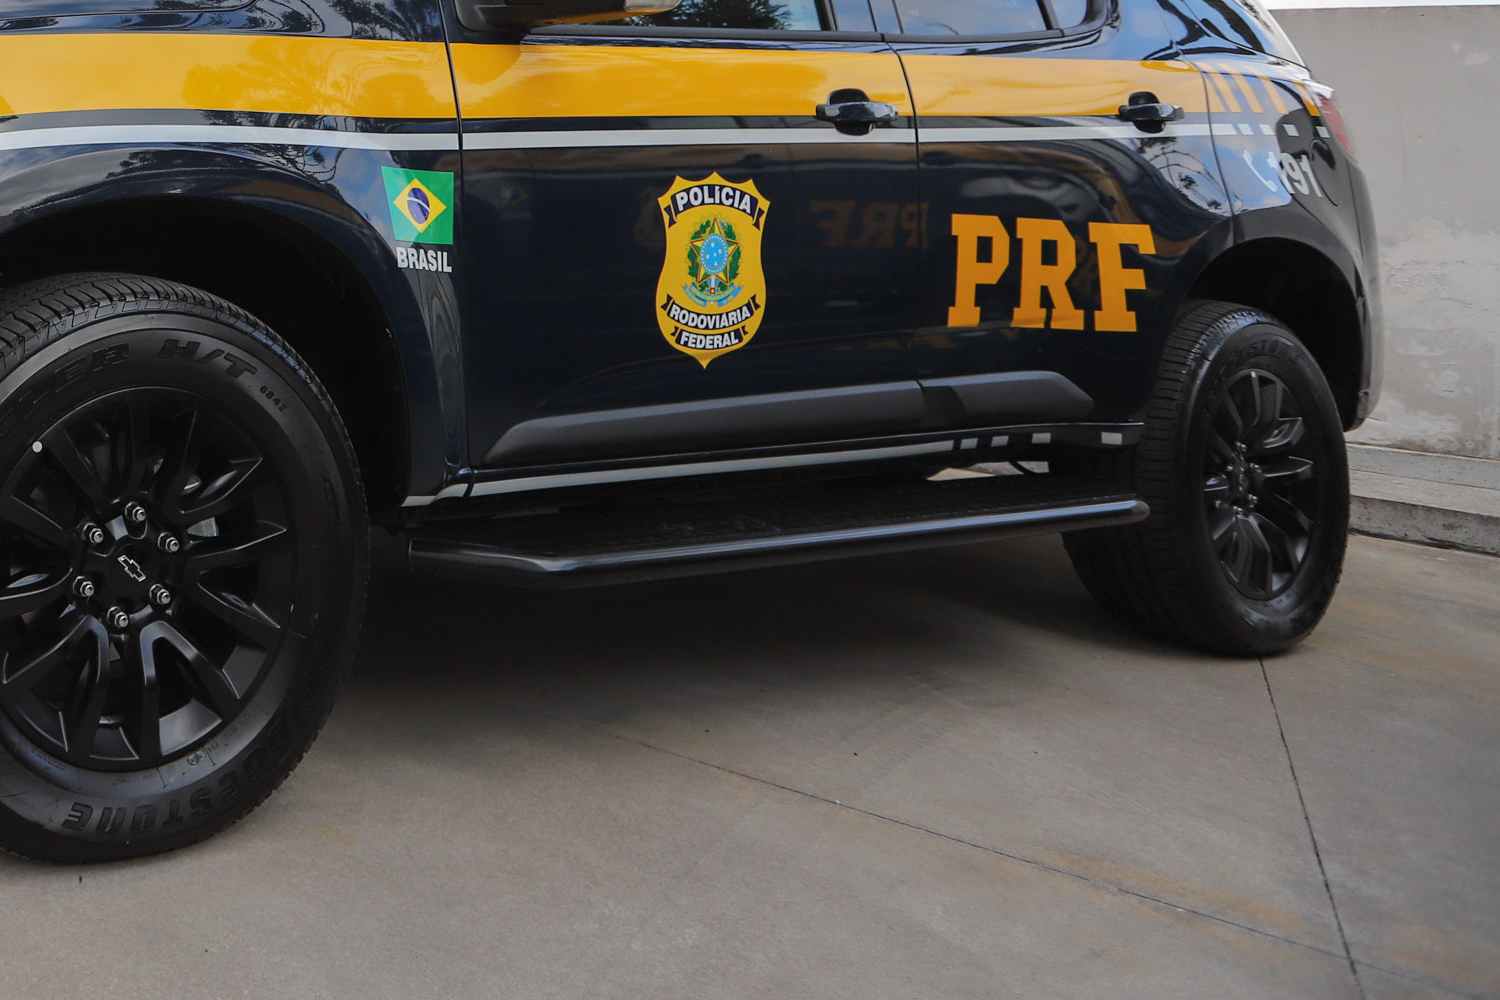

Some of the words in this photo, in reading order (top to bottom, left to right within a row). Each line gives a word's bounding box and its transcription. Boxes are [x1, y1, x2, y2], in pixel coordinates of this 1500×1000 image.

[1266, 151, 1323, 198] 191
[675, 185, 752, 214] POLÍCIA
[395, 246, 453, 273] BRASIL
[947, 213, 1157, 333] PRF
[679, 331, 739, 349] FEDERAL
[159, 337, 258, 379] H/T
